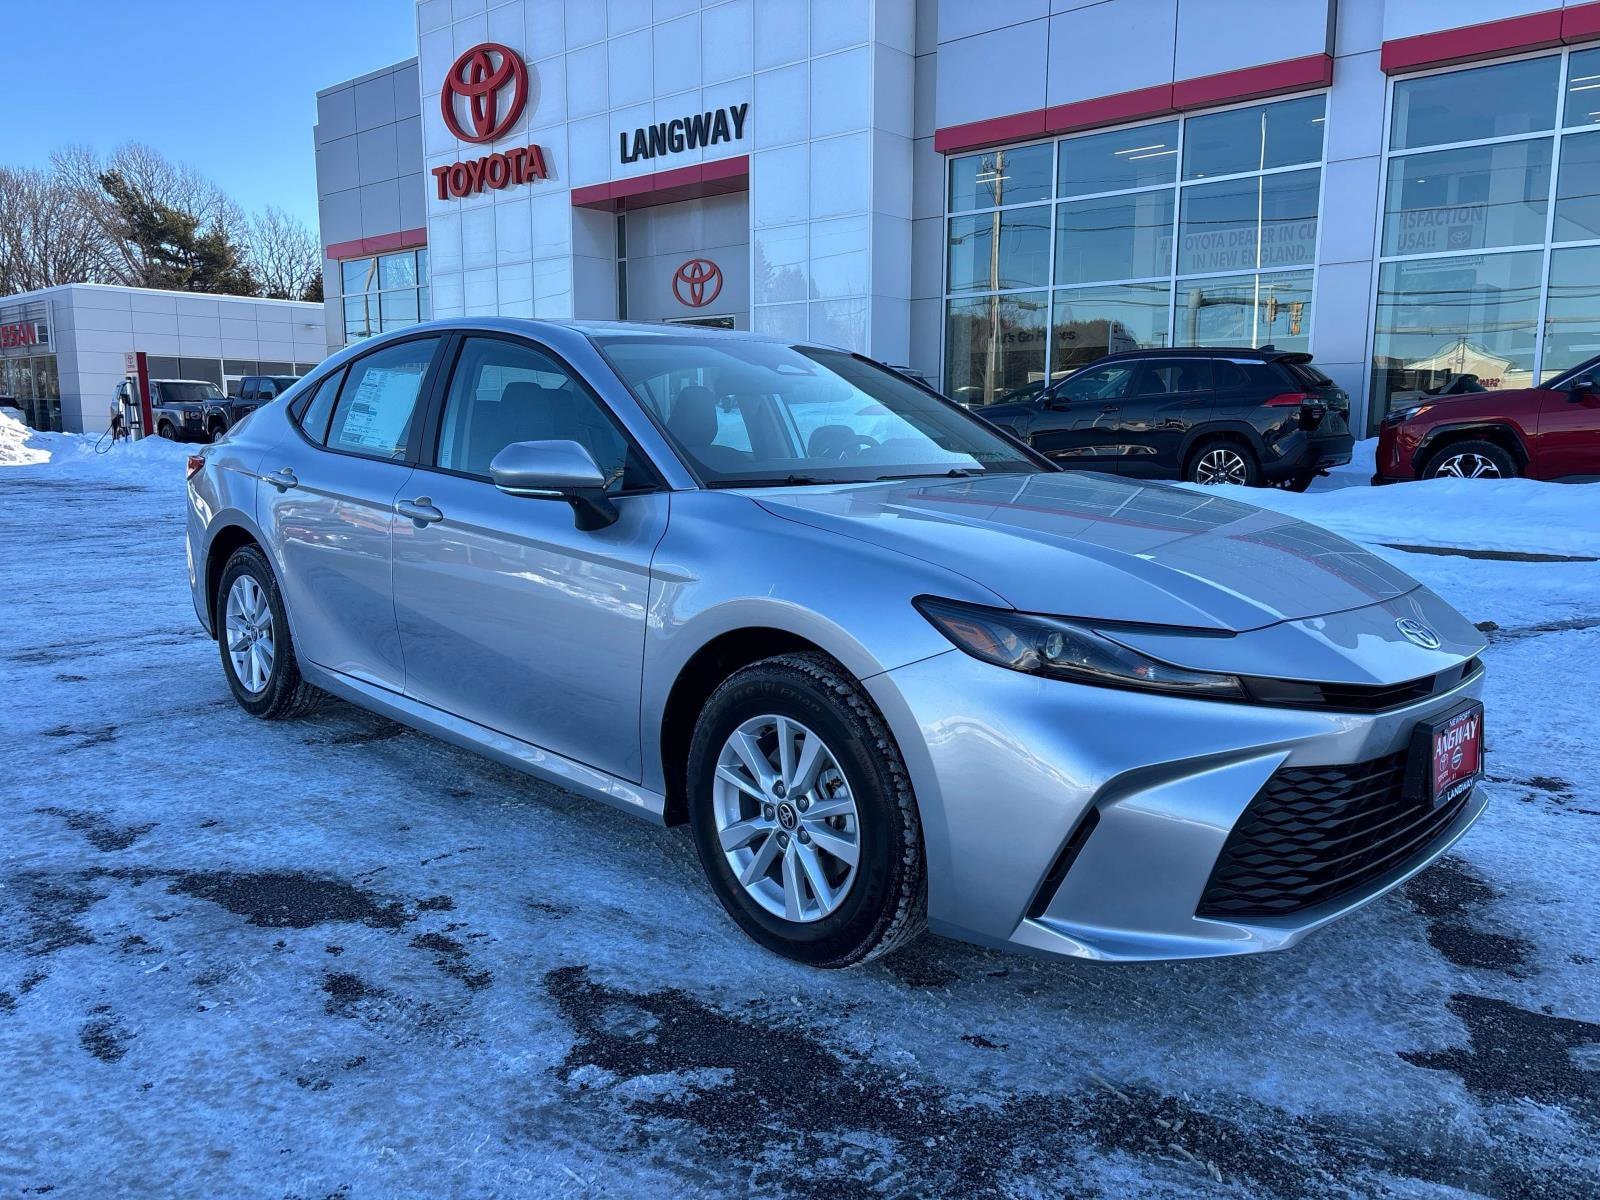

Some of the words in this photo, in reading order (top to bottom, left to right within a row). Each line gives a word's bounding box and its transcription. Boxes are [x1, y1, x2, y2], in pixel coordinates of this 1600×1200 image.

[620, 103, 748, 163] LANGWAY
[432, 145, 547, 200] TOYOTA
[1185, 232, 1225, 250] OYOTA
[1280, 224, 1295, 242] IN
[1193, 254, 1206, 270] IN
[1209, 249, 1238, 268] NEW
[0, 322, 38, 347] SSAN
[1018, 331, 1034, 343] Go
[1447, 777, 1474, 801] LANGWAY
